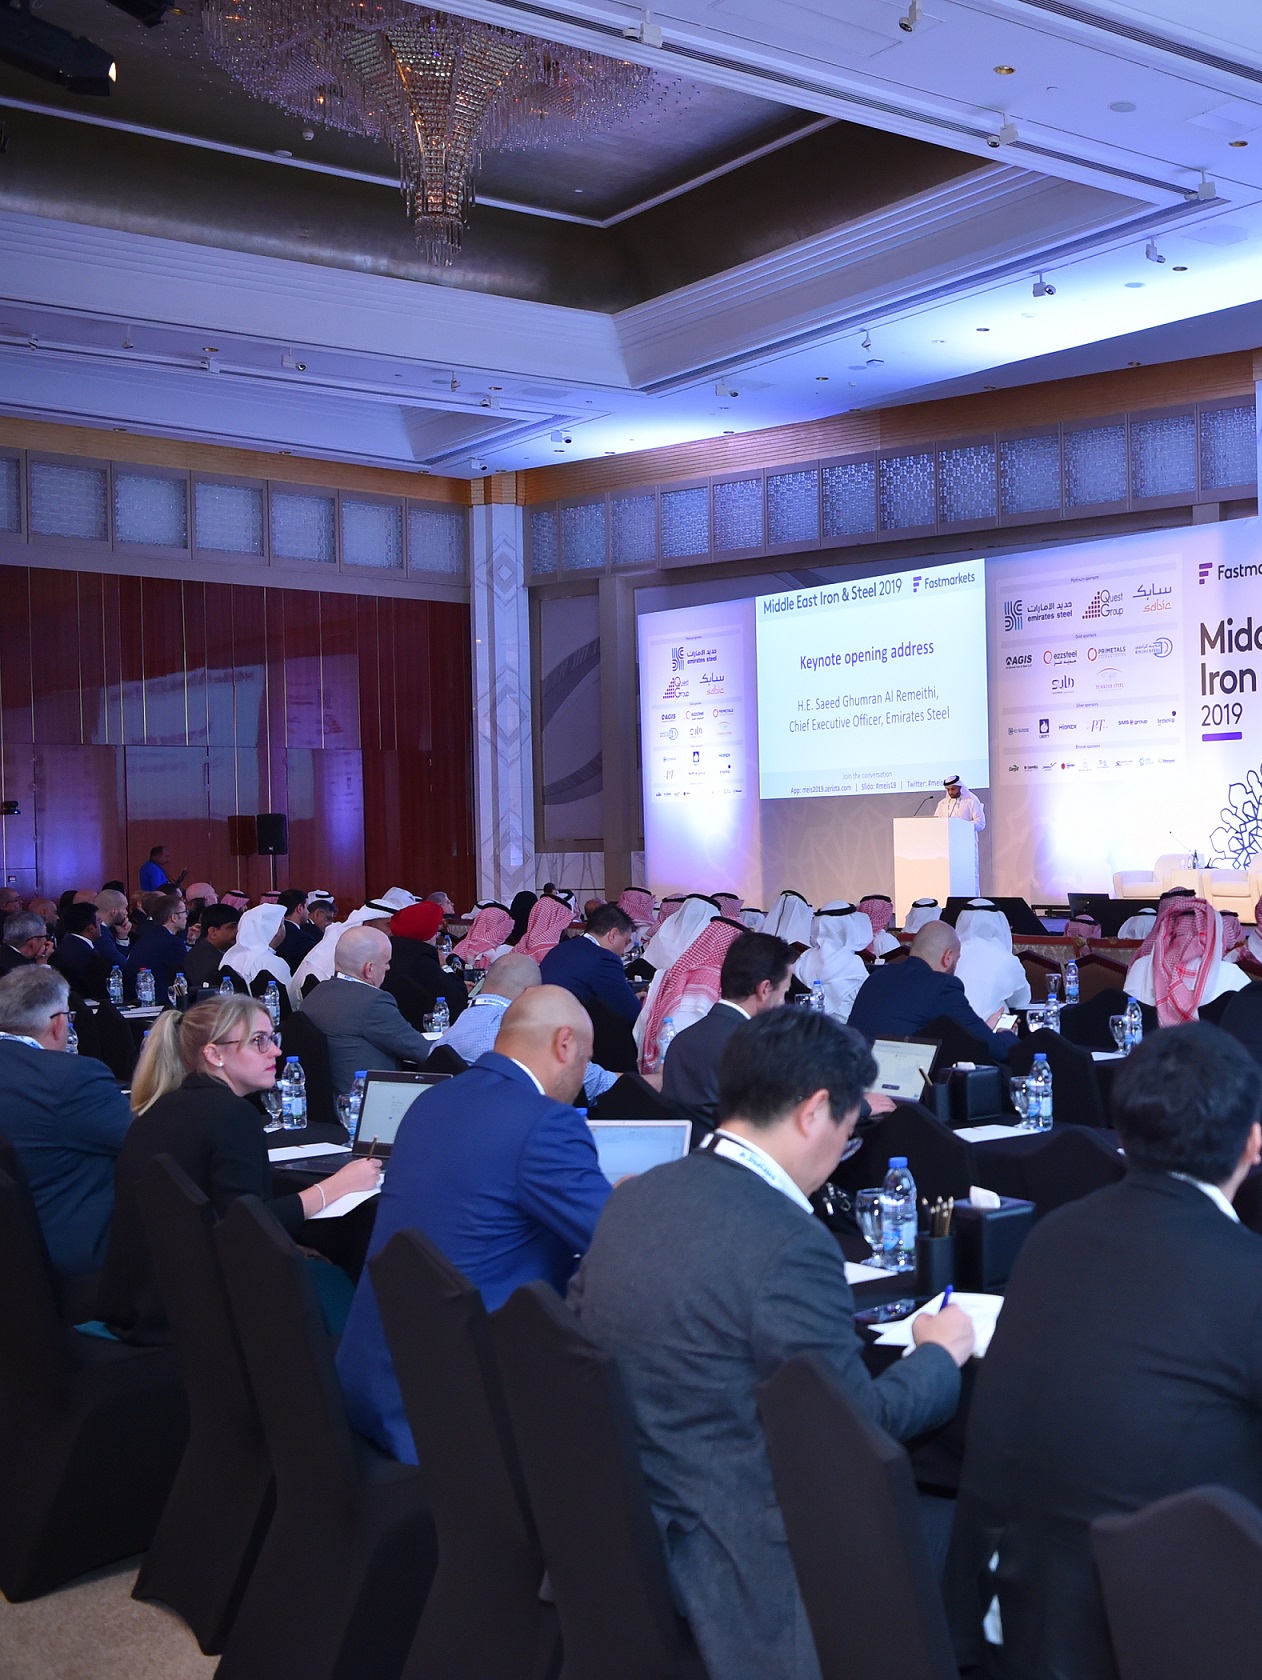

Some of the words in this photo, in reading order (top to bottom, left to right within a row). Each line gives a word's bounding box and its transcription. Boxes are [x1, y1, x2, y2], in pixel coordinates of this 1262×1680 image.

[924, 572, 975, 590] Fastmarkets
[763, 598, 794, 614] Middle
[797, 594, 817, 609] East
[820, 591, 839, 605] Iron
[842, 588, 849, 601] &
[851, 583, 876, 600] Steel
[879, 578, 902, 596] 2019
[1100, 589, 1123, 603] Quest
[1027, 612, 1055, 622] emirates
[1057, 610, 1073, 619] steel
[1100, 604, 1124, 617] Group
[800, 652, 841, 672] Keynote
[844, 646, 888, 667] opening
[891, 641, 934, 659] address
[1053, 650, 1077, 660] ezzsteel
[1098, 646, 1126, 654] PRIMETALS
[1012, 654, 1032, 665] AGIS
[1201, 663, 1256, 696] Iron
[798, 700, 813, 712] H.E.
[815, 696, 840, 710] Saeed
[843, 693, 882, 707] Ghumran
[885, 690, 893, 703] Al
[896, 686, 939, 701] Remeithi,
[789, 719, 810, 733] Chief
[812, 715, 850, 731] Executive
[853, 713, 884, 727] Officer,
[886, 709, 925, 725] Emirates
[927, 706, 950, 721] Steel
[1201, 702, 1243, 726] 2019
[843, 772, 852, 780] Join
[863, 770, 892, 779] conversation
[876, 781, 896, 790] #meis19
[907, 780, 927, 788] Twitter:
